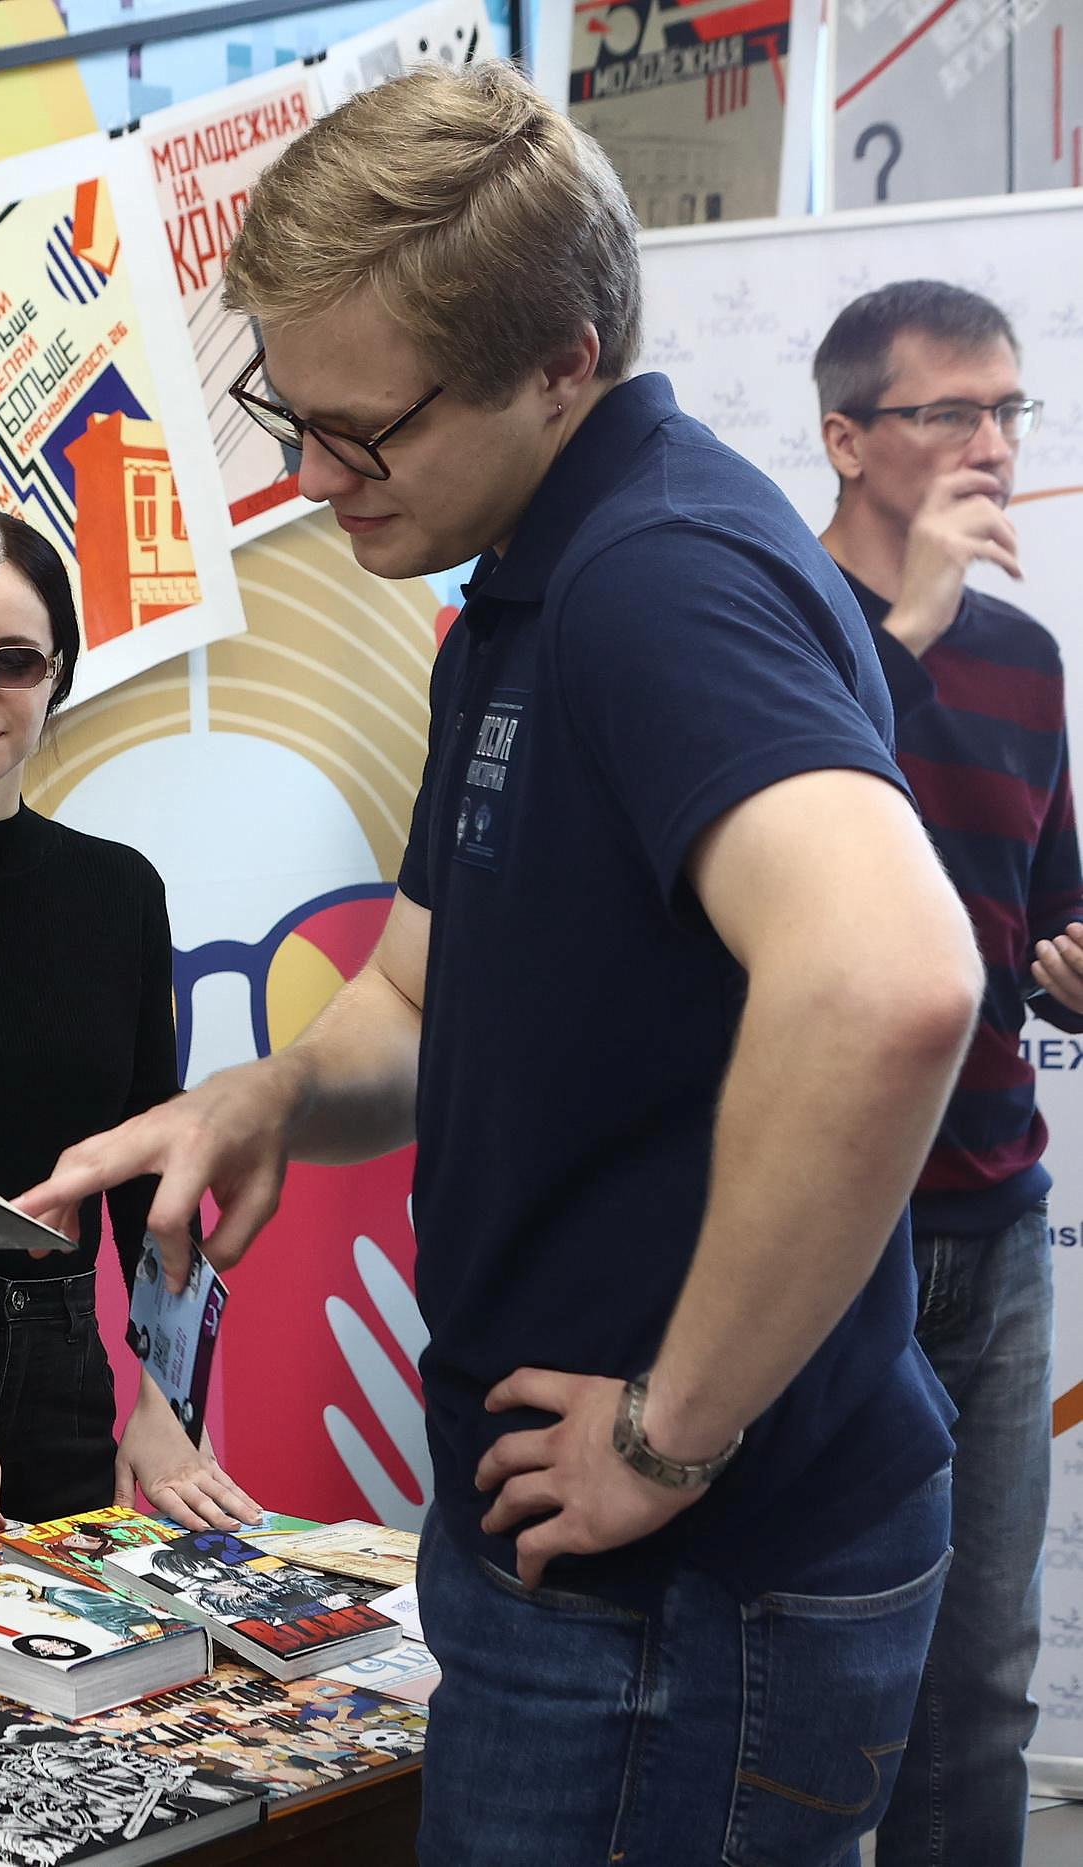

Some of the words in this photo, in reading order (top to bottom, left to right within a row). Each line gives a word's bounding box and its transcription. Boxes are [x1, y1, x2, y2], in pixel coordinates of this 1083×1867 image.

[151, 92, 309, 183] МОЛОДЕЖНАЯ
[172, 174, 205, 209] НА
[193, 1533, 268, 1566] 2
